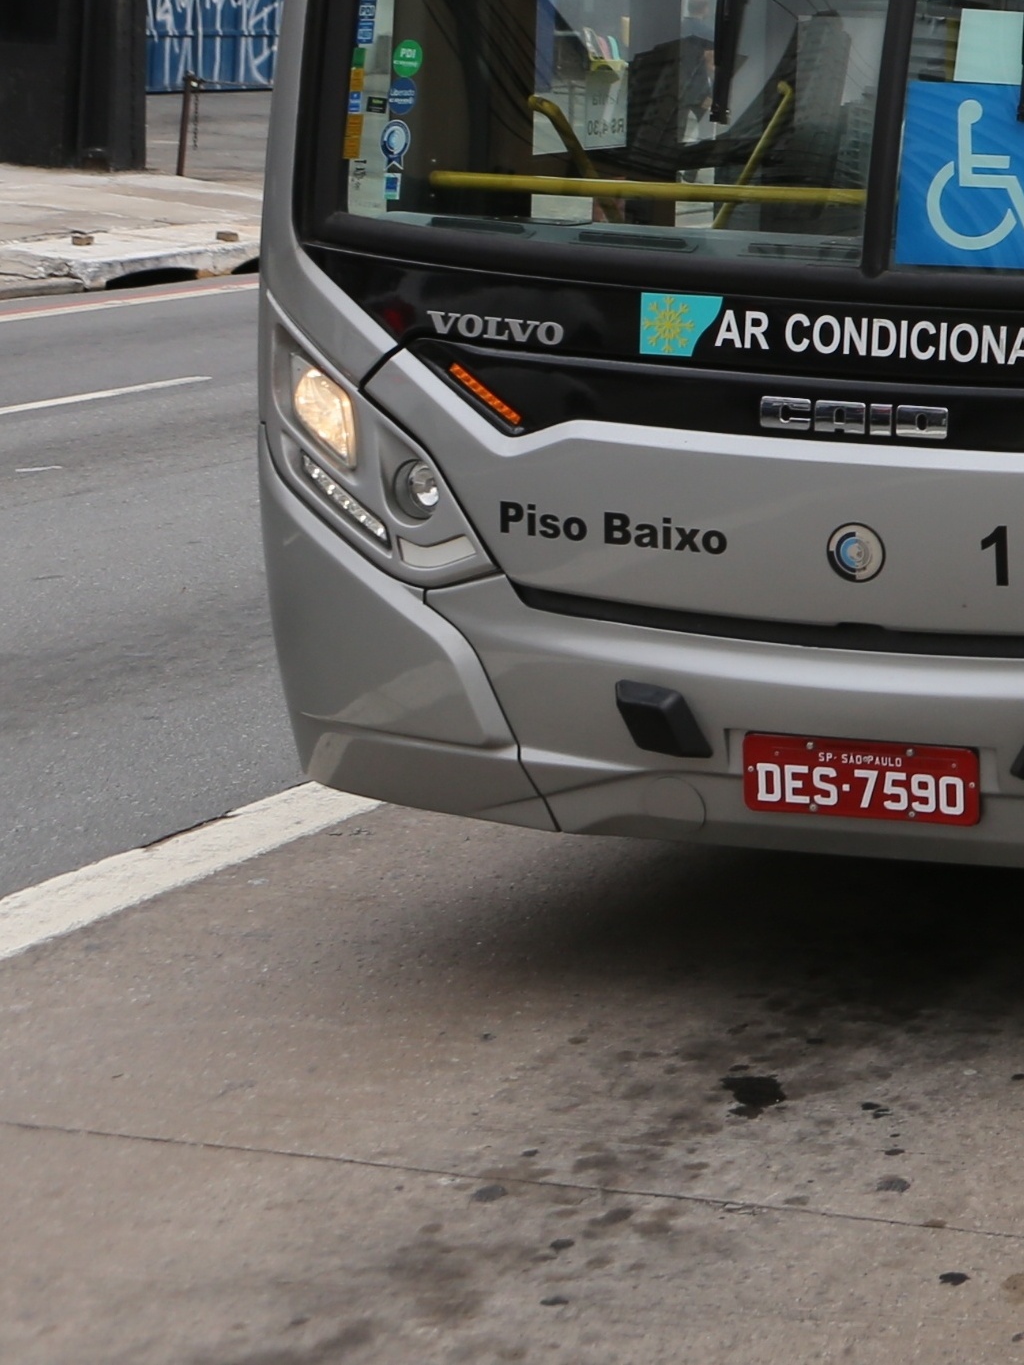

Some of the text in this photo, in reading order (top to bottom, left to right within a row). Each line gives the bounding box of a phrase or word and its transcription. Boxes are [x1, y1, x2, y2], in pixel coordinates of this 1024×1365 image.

[426, 310, 565, 345] VOLVO
[713, 309, 770, 350] AR
[759, 395, 949, 440] CAIO
[499, 500, 728, 555] Piso Baixo
